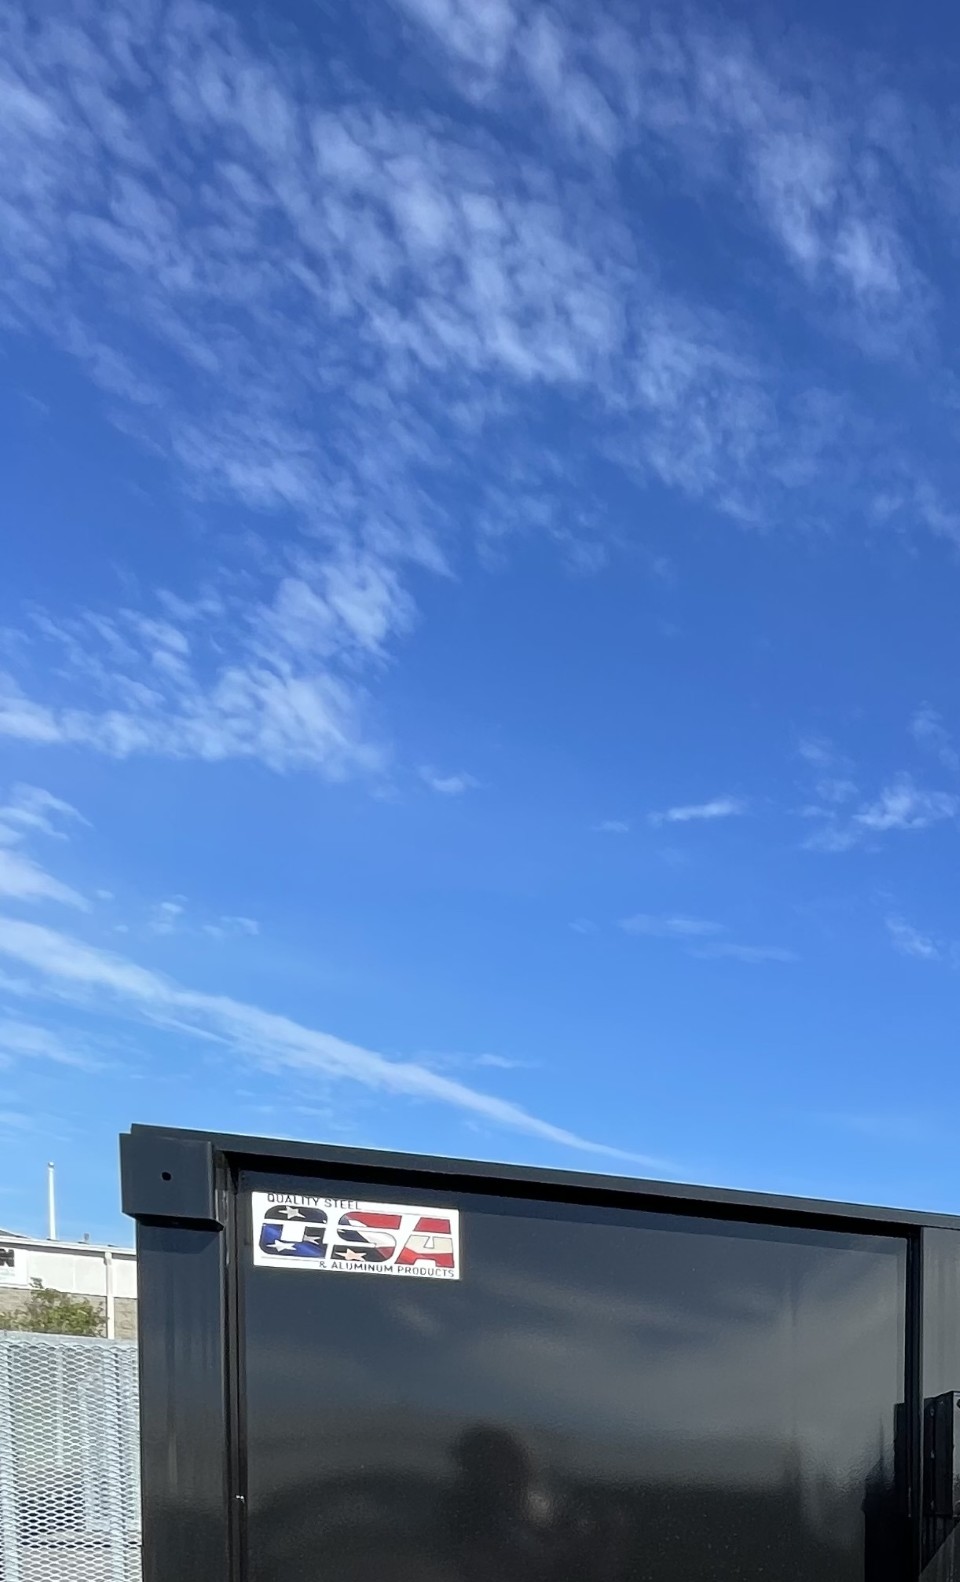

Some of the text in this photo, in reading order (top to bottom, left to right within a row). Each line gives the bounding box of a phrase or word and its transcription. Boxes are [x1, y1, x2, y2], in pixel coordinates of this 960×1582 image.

[267, 1193, 361, 1210] QUALITY STEEL
[259, 1204, 455, 1268] QSA
[331, 1262, 393, 1273] ALUMINUM
[397, 1266, 455, 1279] PRODUCTS
